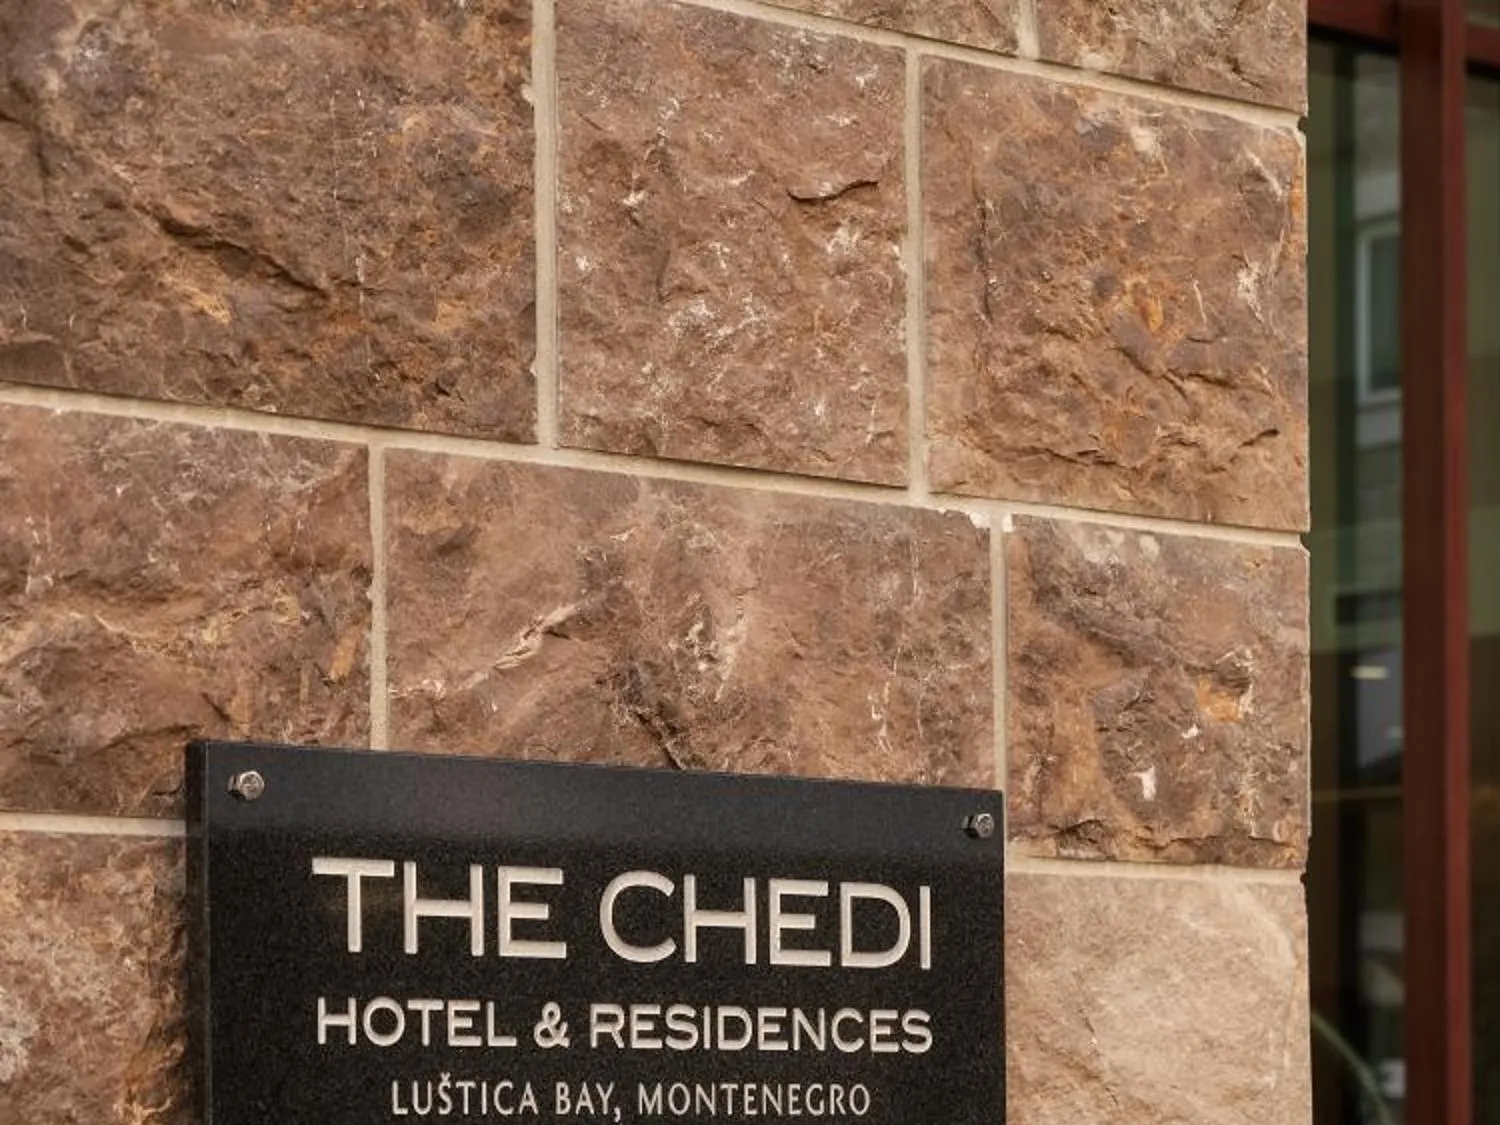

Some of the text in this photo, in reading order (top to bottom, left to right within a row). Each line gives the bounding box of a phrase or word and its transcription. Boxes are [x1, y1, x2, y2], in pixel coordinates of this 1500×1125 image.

[311, 857, 932, 970] THE CHEDI
[317, 997, 933, 1054] HOTEL & RESIDENCES
[391, 1071, 872, 1123] LUŠTICA BAY, MONTENEGRO
